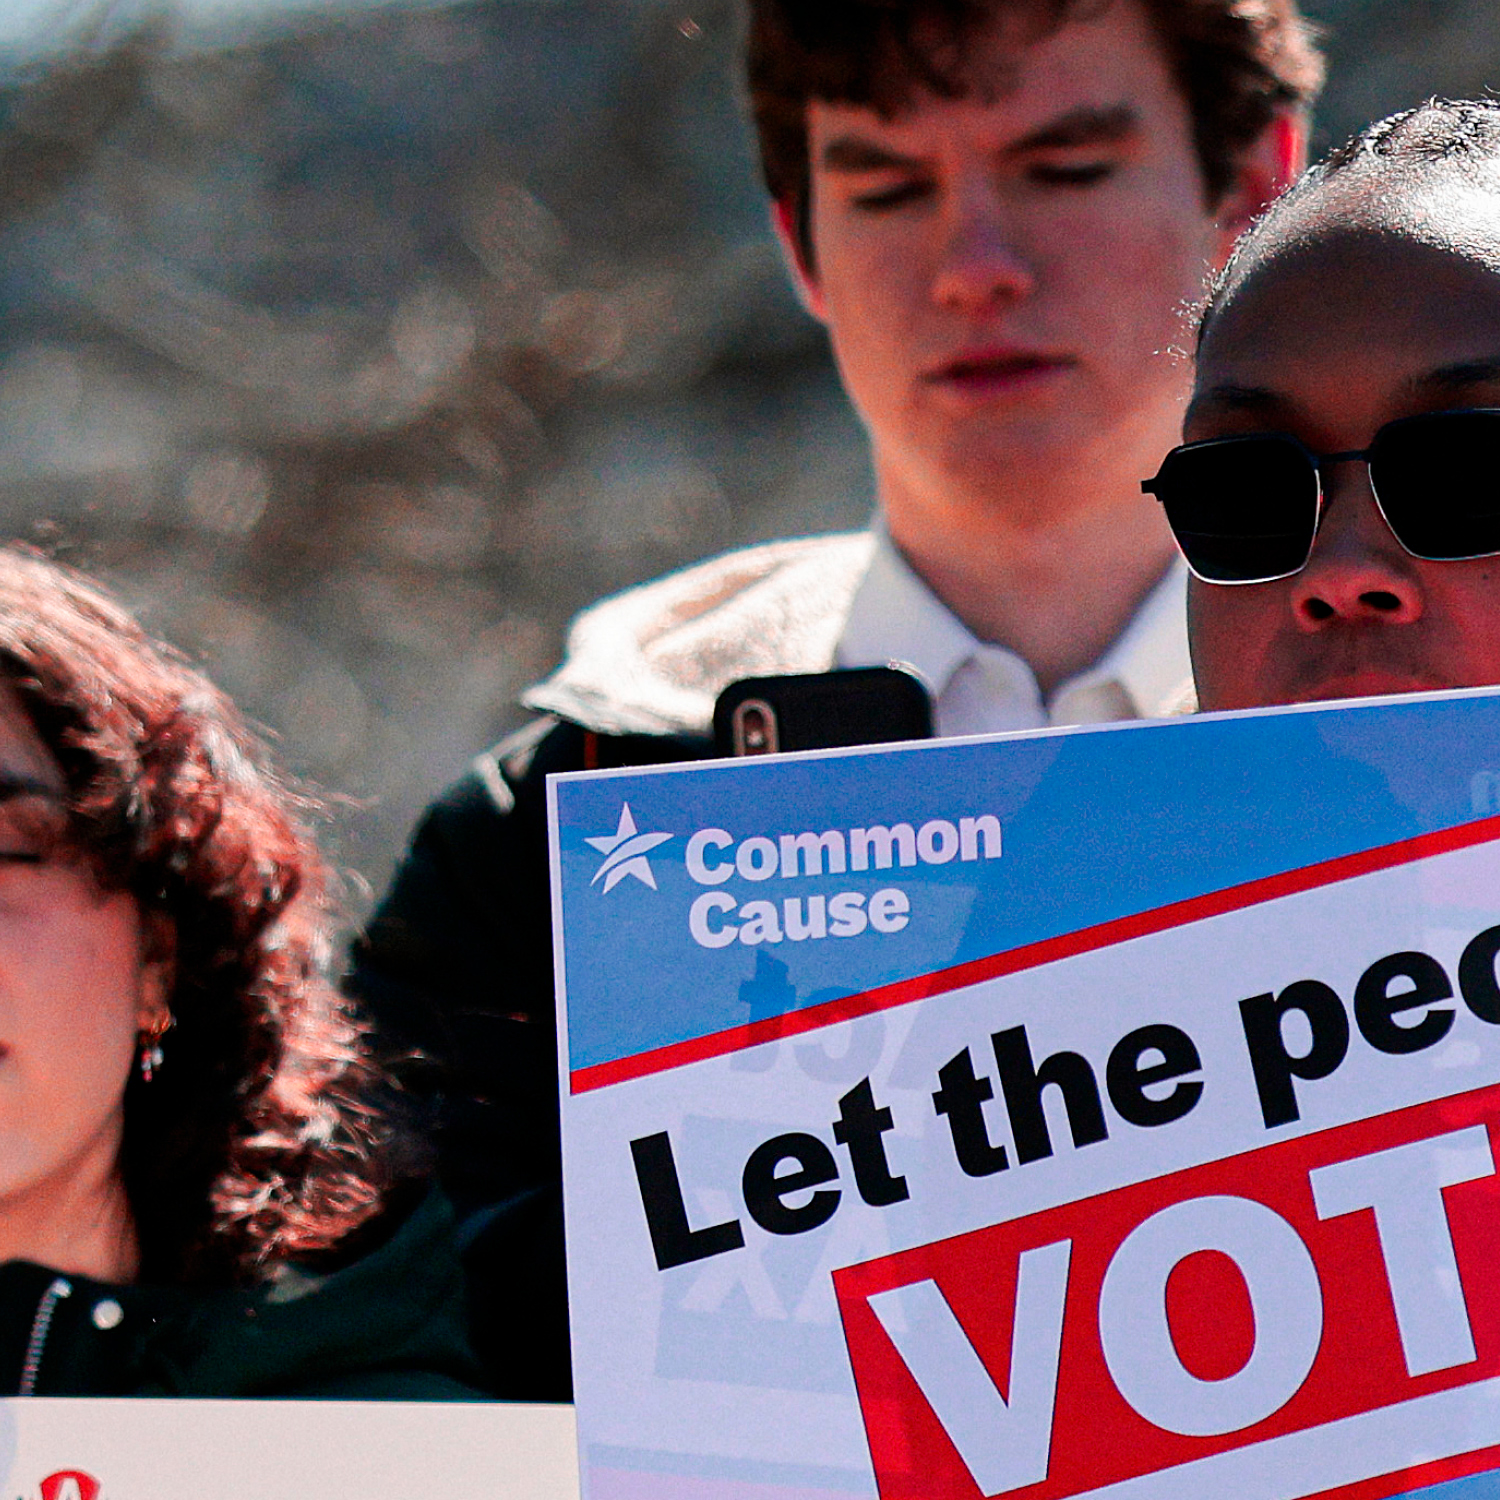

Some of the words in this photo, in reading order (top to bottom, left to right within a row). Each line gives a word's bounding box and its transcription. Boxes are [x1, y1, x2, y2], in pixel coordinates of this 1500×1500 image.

[685, 814, 1002, 885] Common
[688, 887, 911, 948] Cause
[629, 1076, 911, 1271] Let
[931, 1023, 1205, 1179] the
